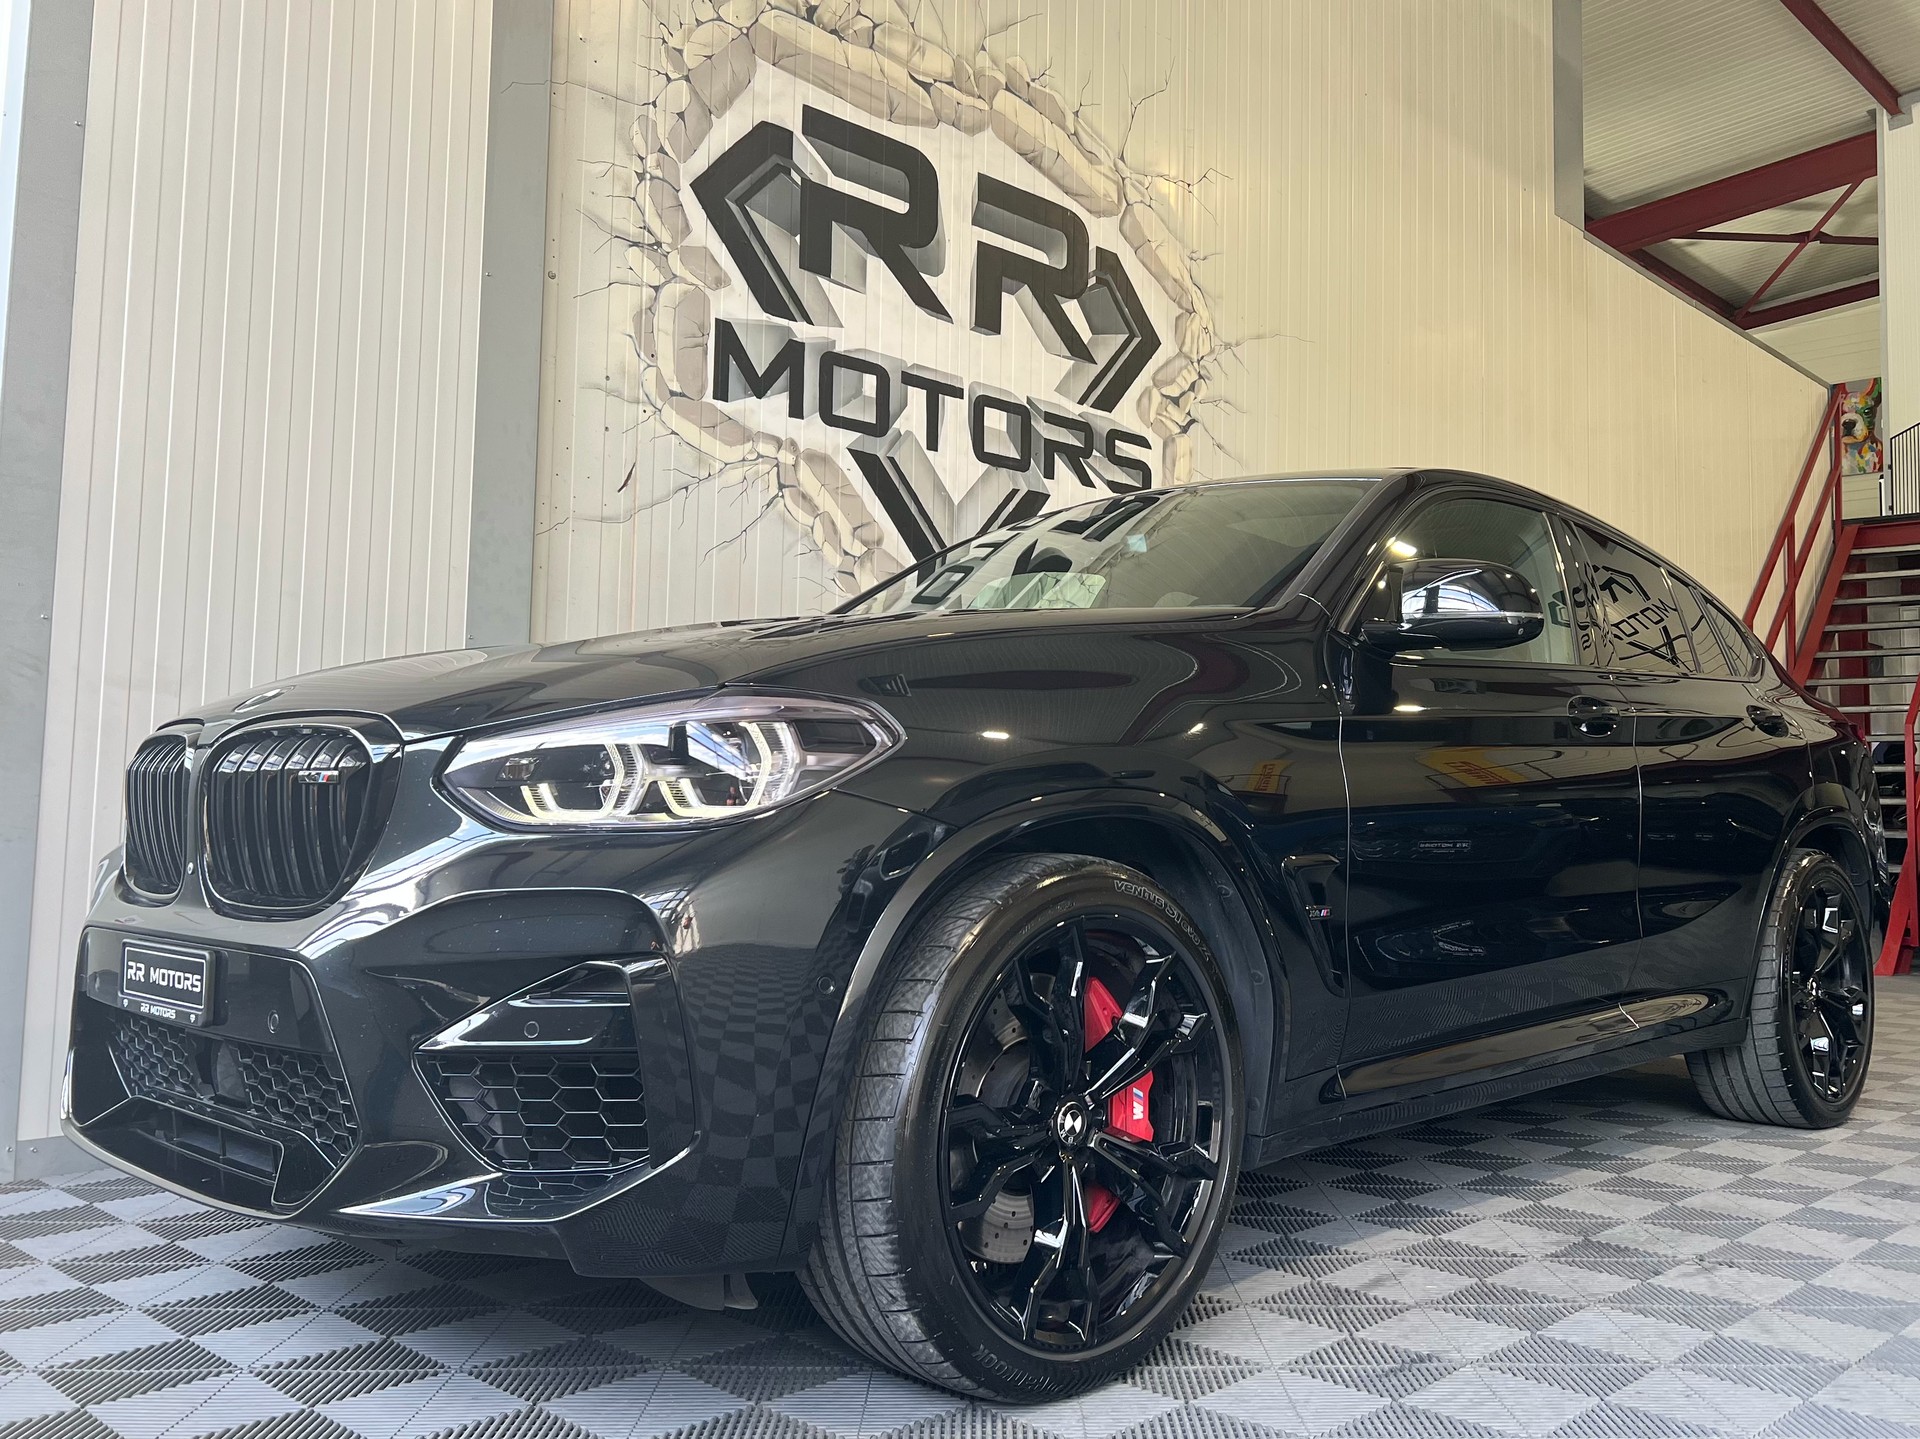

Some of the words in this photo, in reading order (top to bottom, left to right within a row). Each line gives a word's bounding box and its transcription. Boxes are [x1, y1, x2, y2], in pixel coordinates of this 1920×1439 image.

[799, 104, 1096, 365] RR
[713, 317, 1152, 494] MOTORS
[128, 961, 145, 982] RR
[149, 967, 202, 992] MOTORS
[141, 1003, 150, 1013] RR
[150, 1006, 176, 1019] MOTORS
